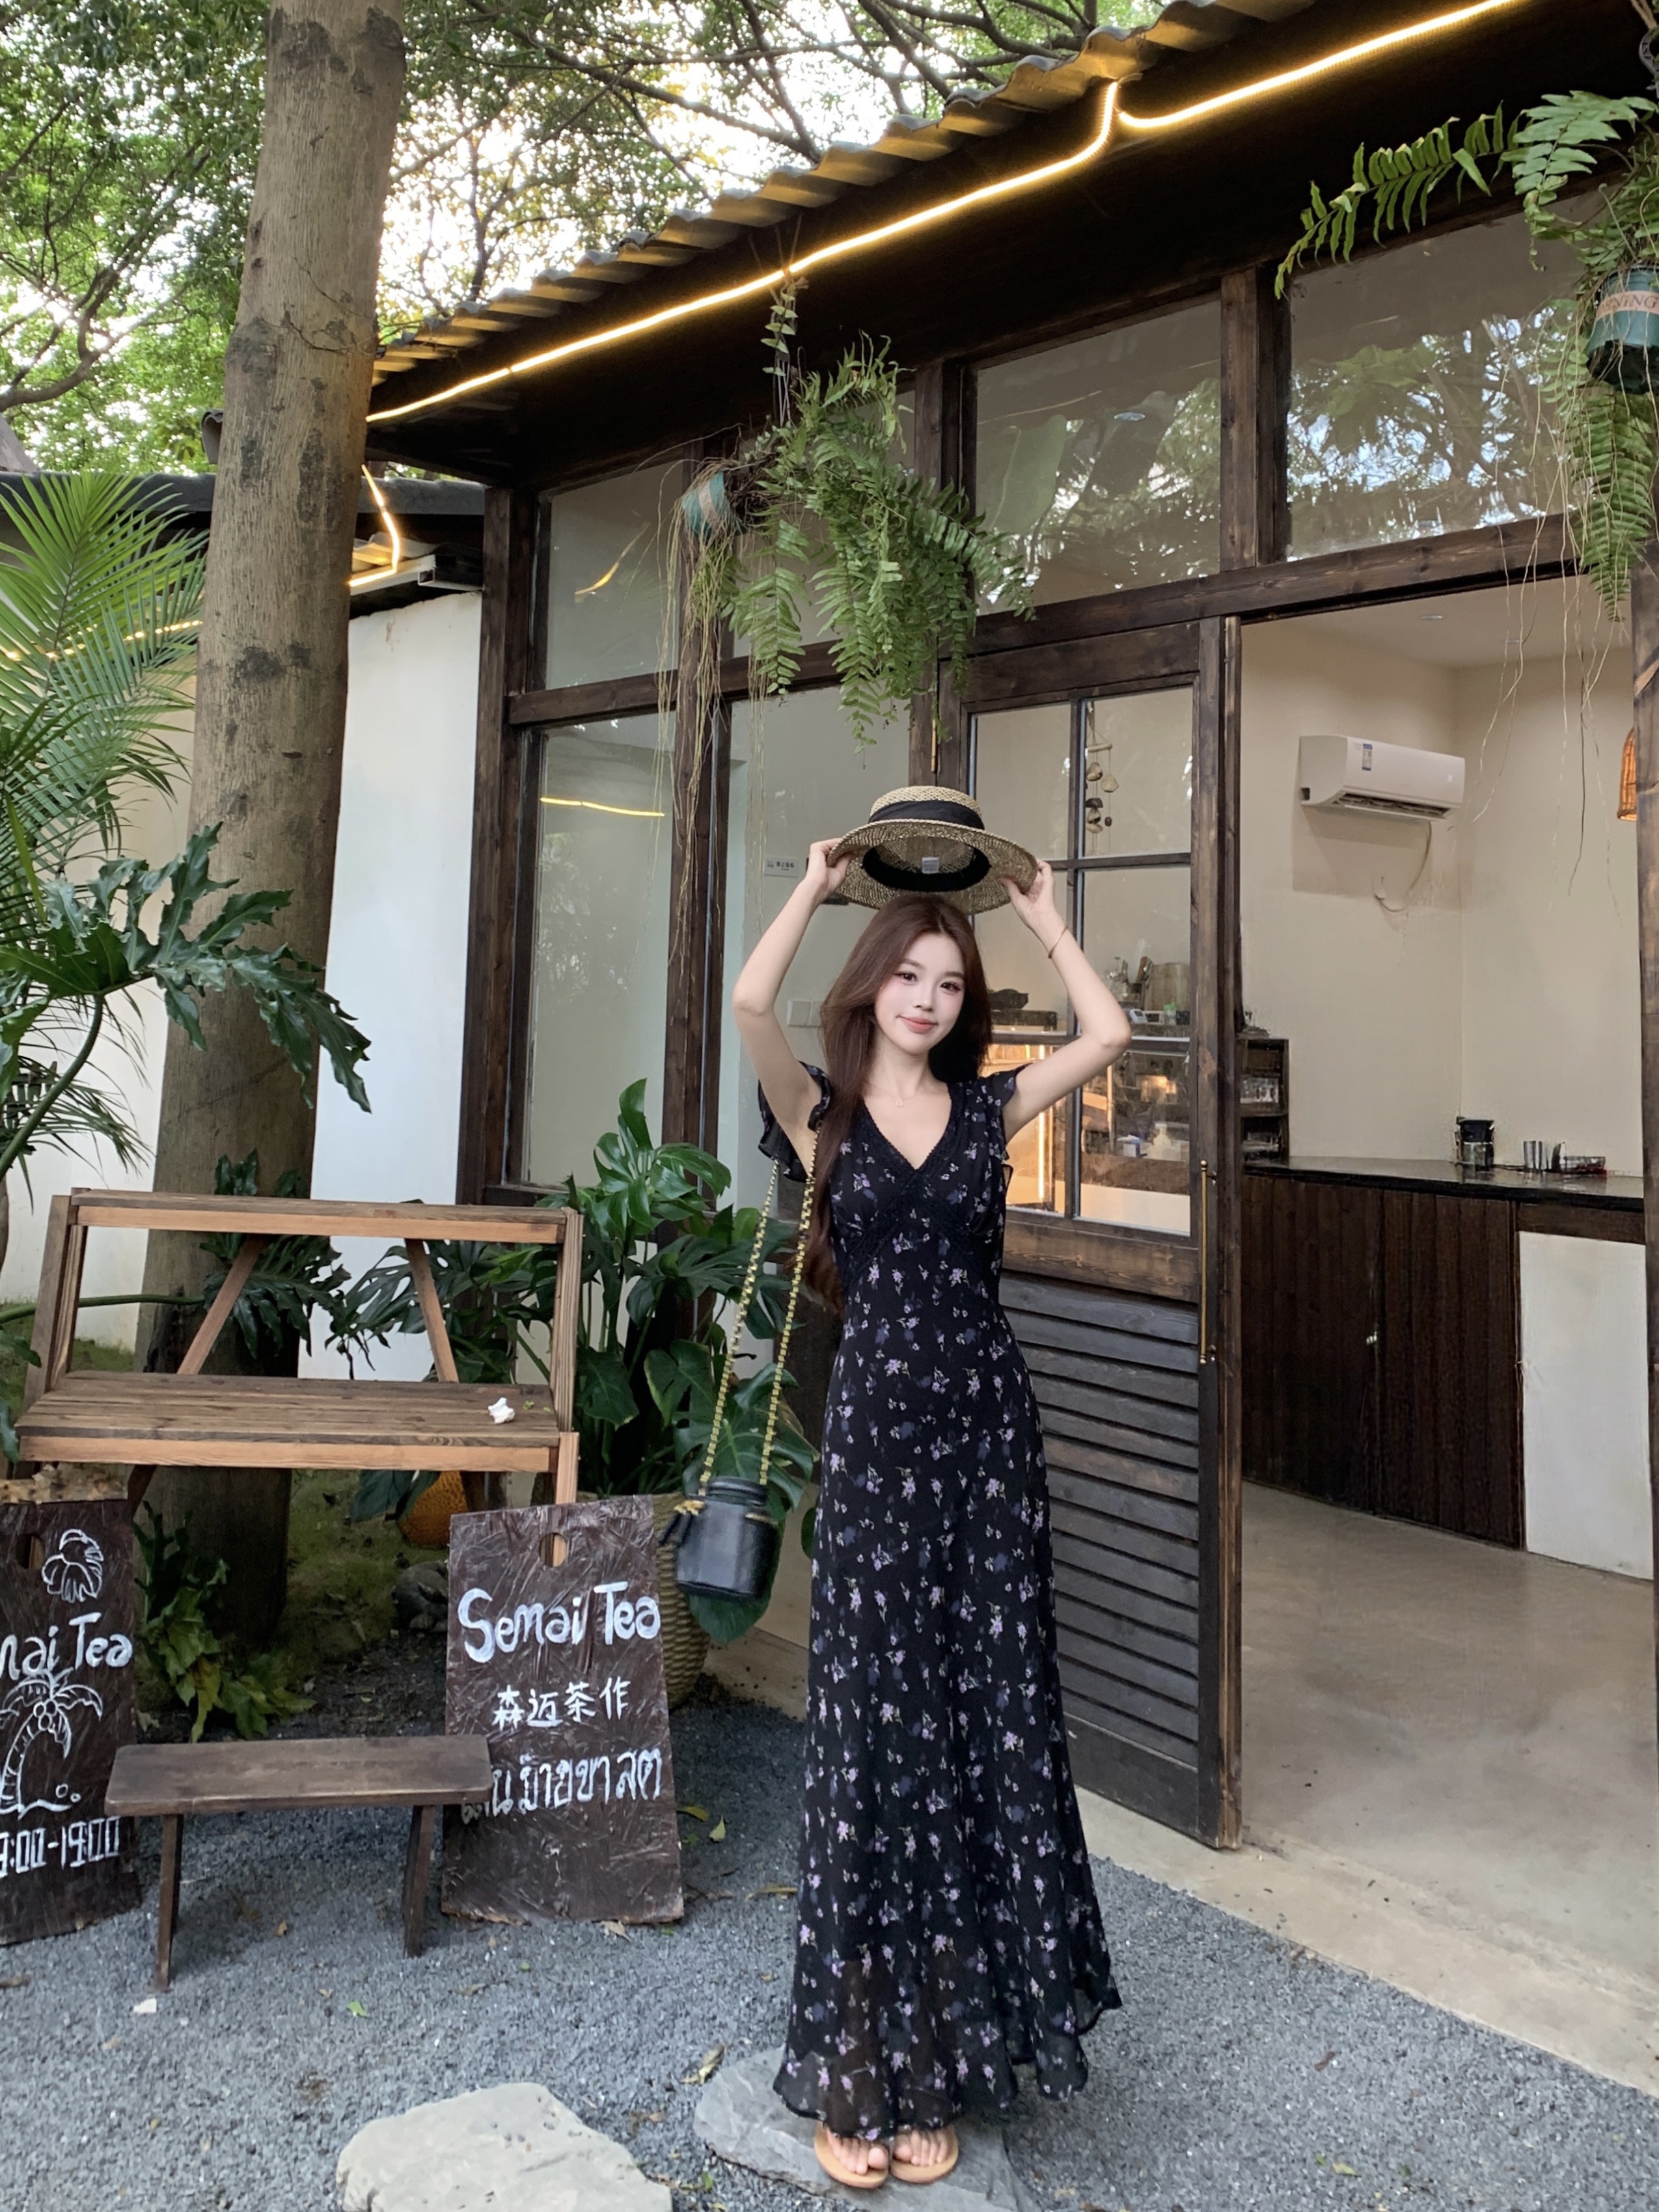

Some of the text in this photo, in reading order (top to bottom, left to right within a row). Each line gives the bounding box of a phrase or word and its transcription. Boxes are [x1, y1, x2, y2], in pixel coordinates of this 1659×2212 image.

[69, 1612, 133, 1671] Tea
[458, 1581, 661, 1663] Semai Tea
[491, 1676, 631, 1731] 森迈茶作
